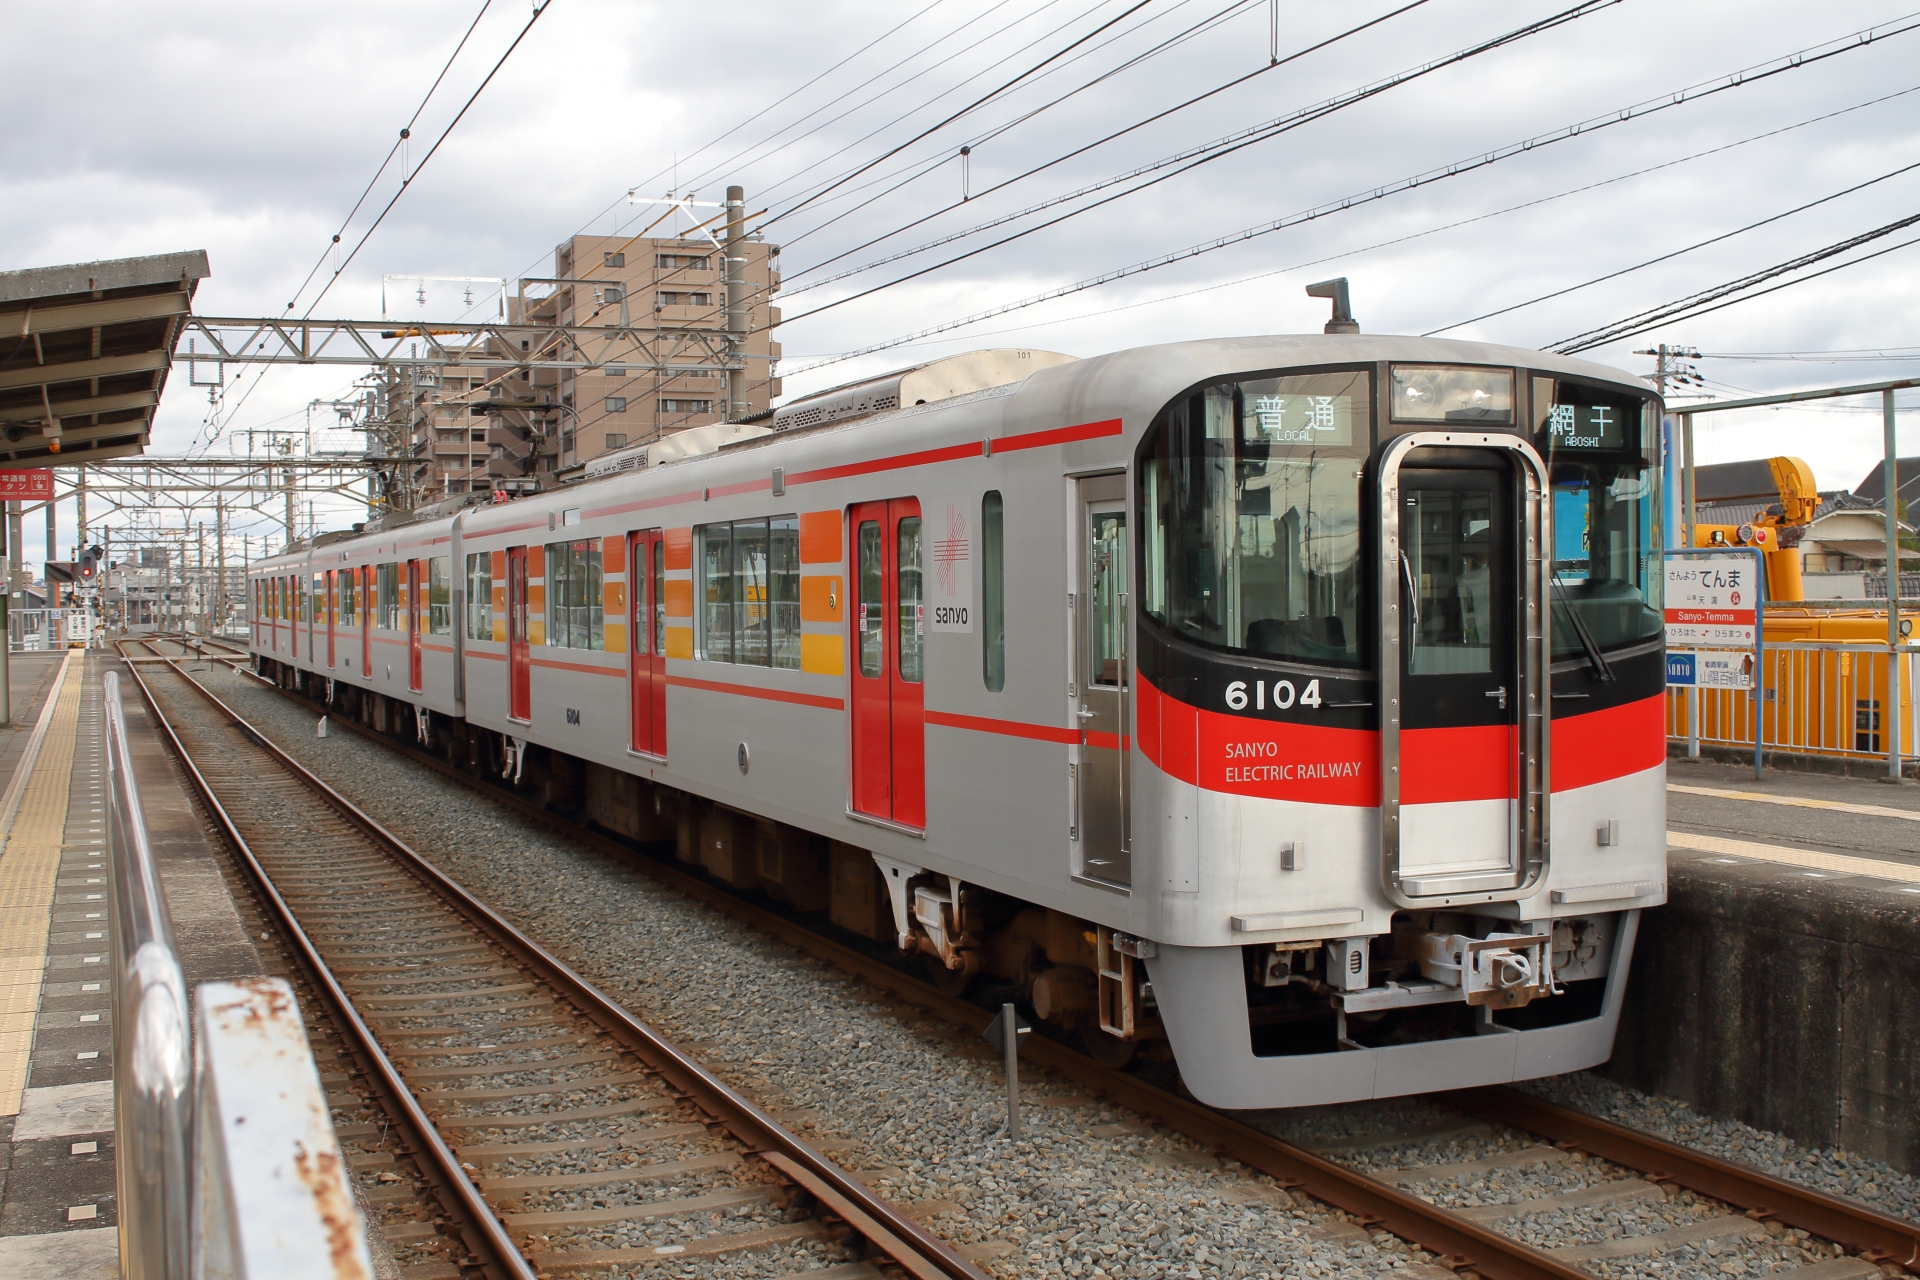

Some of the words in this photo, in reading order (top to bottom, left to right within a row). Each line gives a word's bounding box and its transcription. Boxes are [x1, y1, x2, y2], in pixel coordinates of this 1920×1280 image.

[1016, 351, 1031, 359] 101
[1255, 395, 1336, 431] 普通
[1549, 404, 1613, 437] 網干
[1276, 430, 1314, 442] LOCAL
[1564, 436, 1600, 447] ABOSHI
[0, 474, 27, 482] 常通報
[1669, 570, 1697, 581] さんよう
[1699, 569, 1741, 589] てんま
[1698, 595, 1718, 606] 天満
[935, 606, 968, 625] sanyo
[1677, 611, 1735, 623] Sanyo-Temma
[1670, 628, 1697, 637] ひろはた
[1714, 629, 1742, 638] ひらまつ
[1667, 663, 1690, 677] SANYO
[1225, 679, 1322, 711] 6104
[566, 707, 580, 727] 6104
[1225, 741, 1278, 759] SANYO
[1225, 765, 1294, 783] ELECTRIC
[1297, 761, 1362, 780] RAILWAY
